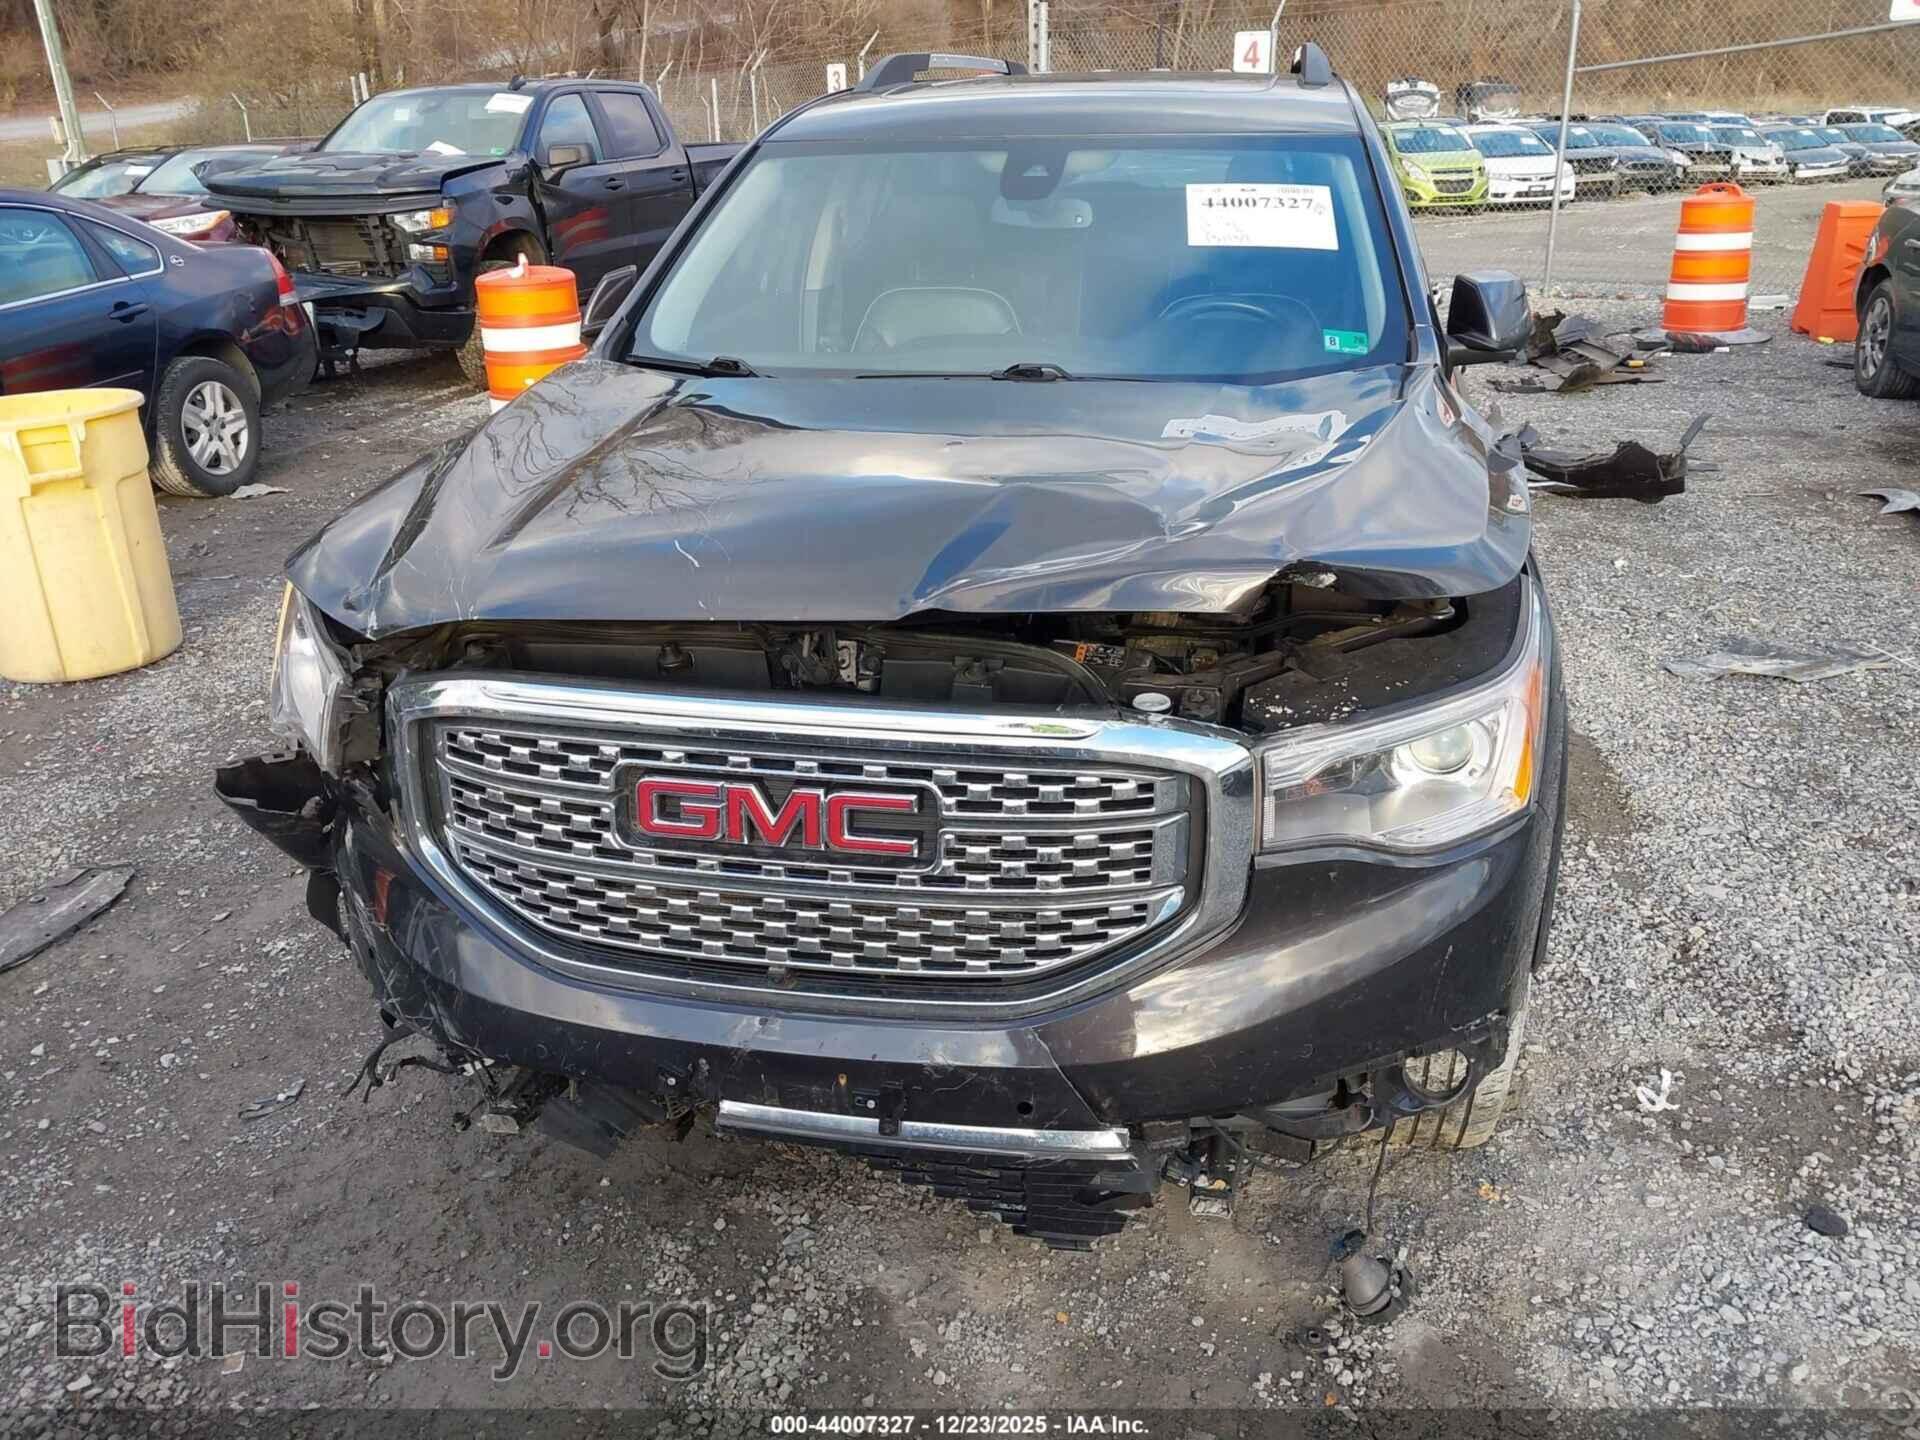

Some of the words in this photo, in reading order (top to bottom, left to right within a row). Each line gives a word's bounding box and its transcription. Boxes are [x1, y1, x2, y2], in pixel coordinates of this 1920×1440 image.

[1243, 40, 1260, 65] 4
[832, 70, 841, 91] 3
[1201, 197, 1313, 209] 44007327
[636, 775, 918, 858] GMC
